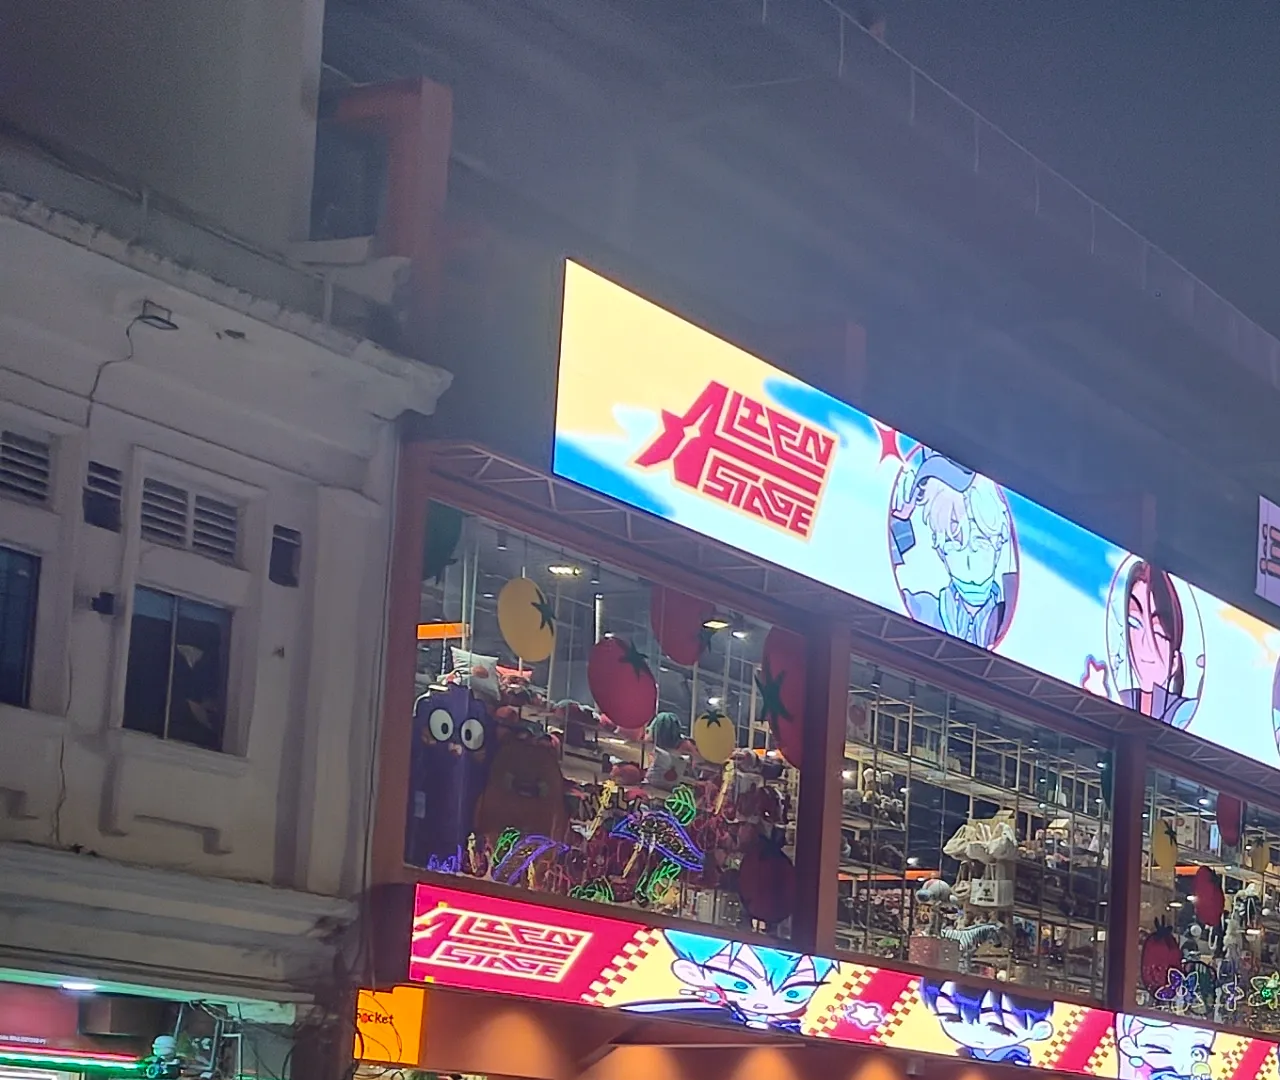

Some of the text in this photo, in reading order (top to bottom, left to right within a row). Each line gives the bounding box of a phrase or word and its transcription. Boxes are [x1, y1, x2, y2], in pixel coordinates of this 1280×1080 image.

[634, 381, 836, 488] ALIEN
[702, 457, 814, 536] STAGE
[437, 942, 565, 979] STAGE
